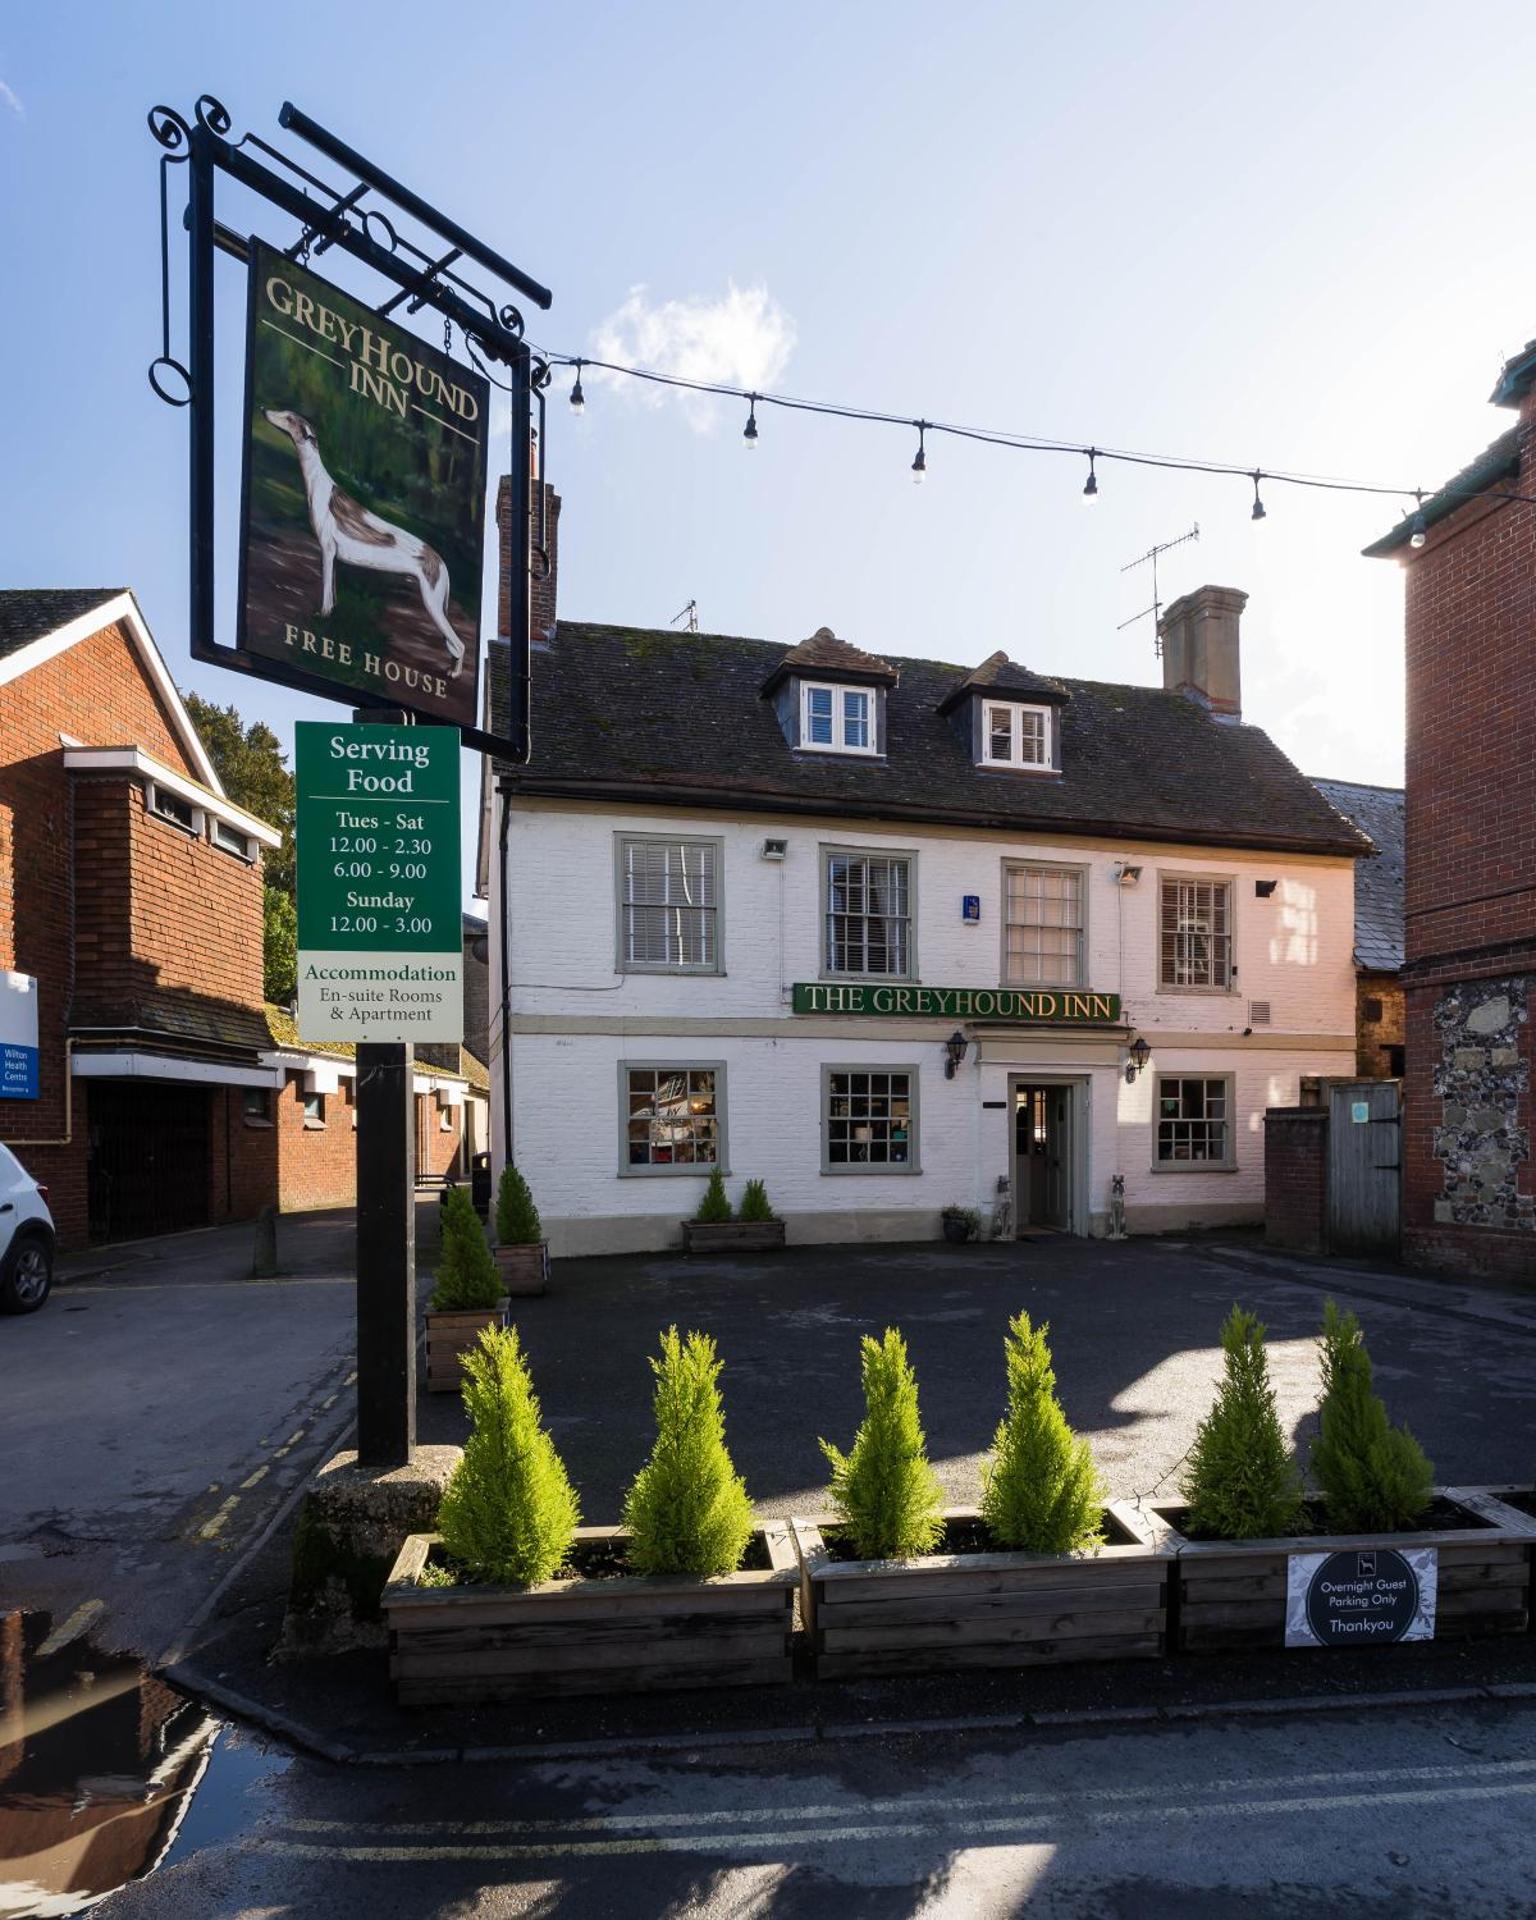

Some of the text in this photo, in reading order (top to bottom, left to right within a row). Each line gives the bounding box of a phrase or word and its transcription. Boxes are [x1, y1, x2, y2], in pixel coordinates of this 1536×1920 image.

[266, 277, 479, 422] GREYHOUND
[350, 361, 409, 418] INN
[284, 624, 447, 699] FREE HOUSE
[330, 736, 430, 768] Serving
[347, 769, 413, 793] Food
[336, 811, 378, 829] Tues
[396, 813, 424, 831] Sat
[330, 837, 377, 853] 12.00
[395, 839, 431, 855] 2.30
[334, 862, 371, 878] 6.00
[389, 863, 426, 879] 9.00
[347, 891, 415, 913] Sunday
[330, 916, 377, 932] 12.00
[395, 917, 432, 933] 3.00
[305, 964, 456, 982] Accommodation
[320, 988, 442, 1004] En-suite Rooms
[804, 986, 1111, 1018] THE GREYHOUND INN
[331, 1006, 432, 1024] & Apartment
[4, 1048, 28, 1060] Wilton
[4, 1060, 28, 1071] Health
[4, 1070, 28, 1082] Centre
[1321, 1578, 1407, 1594] Overnight Guest
[1329, 1593, 1398, 1607] Parking Only
[1330, 1617, 1394, 1634] Thankyou
